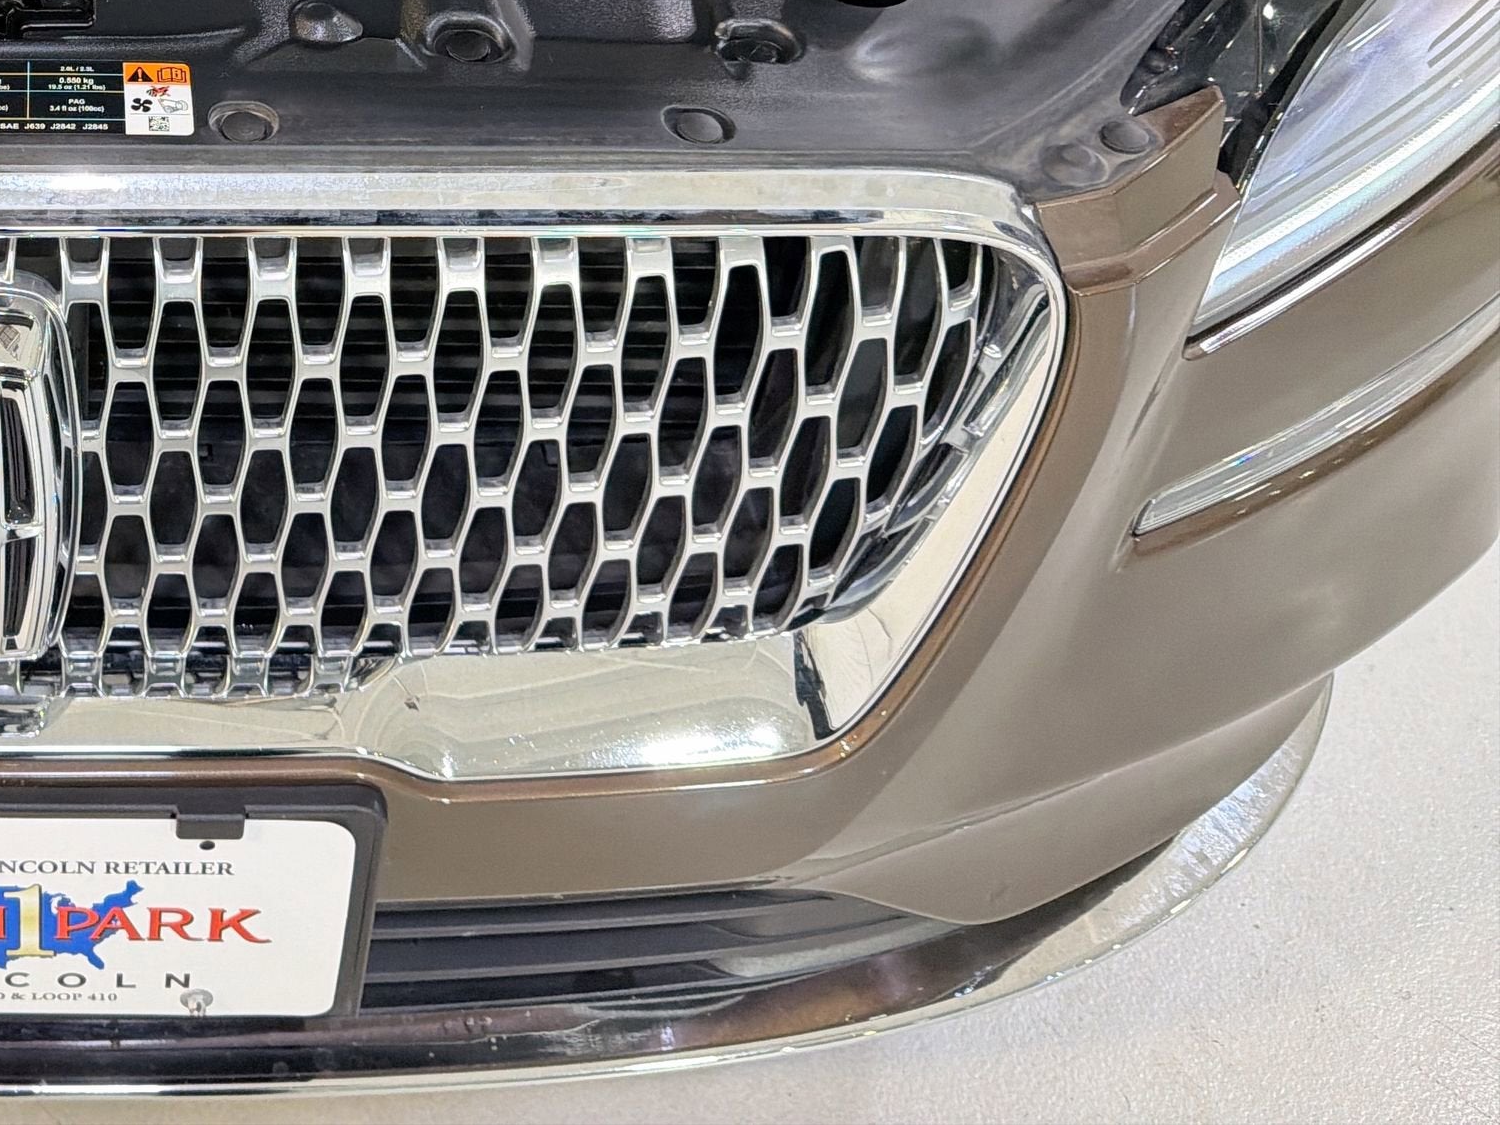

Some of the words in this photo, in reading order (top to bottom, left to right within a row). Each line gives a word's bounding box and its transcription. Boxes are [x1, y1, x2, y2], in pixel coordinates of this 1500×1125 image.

[83, 77, 94, 86] kg
[0, 122, 19, 130] SAE
[104, 861, 235, 876] RETAILER
[54, 906, 273, 944] PARK
[11, 992, 26, 1001] &
[31, 992, 83, 1001] LOOP
[87, 992, 118, 1002] 410
